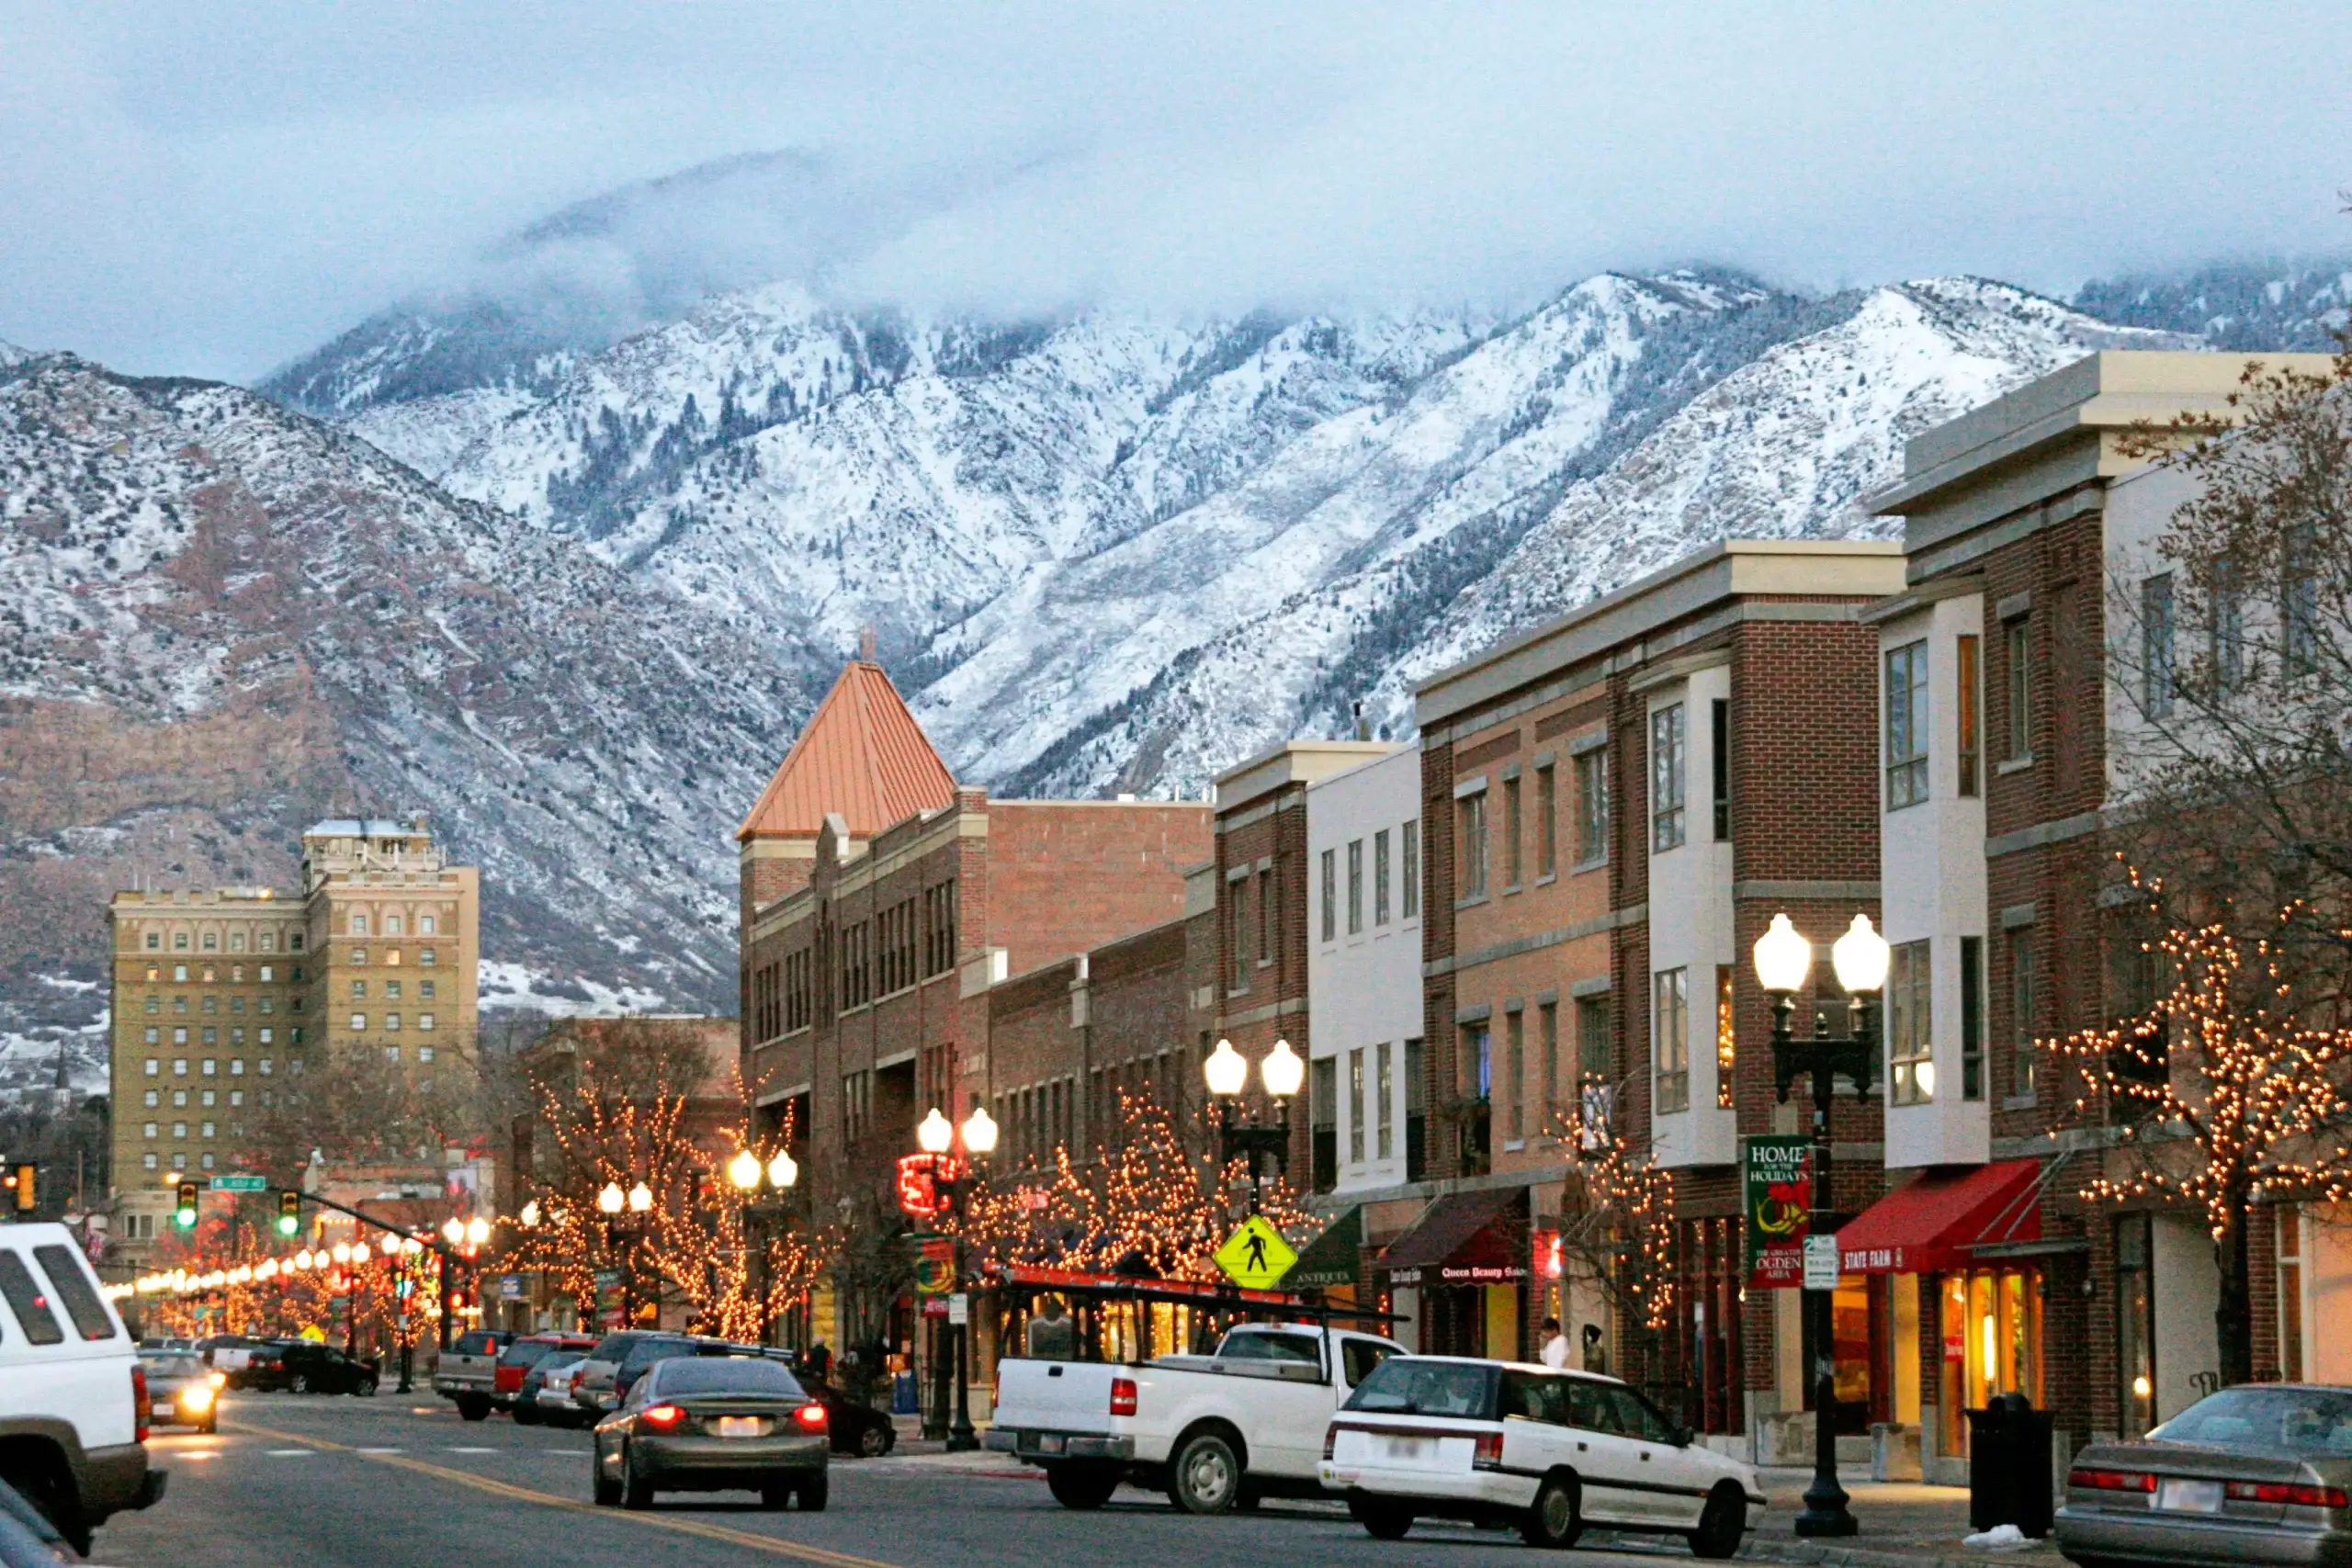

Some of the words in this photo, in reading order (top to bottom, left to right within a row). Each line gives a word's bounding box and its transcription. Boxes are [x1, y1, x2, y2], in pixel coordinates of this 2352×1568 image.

[1751, 1146, 1804, 1163] HOME
[1750, 1171, 1808, 1182] HOLIDAYS
[1756, 1256, 1802, 1269] OGDEN
[1845, 1250, 1867, 1269] STATE
[1870, 1249, 1891, 1267] FARM
[1442, 1267, 1470, 1278] Queen
[1472, 1267, 1502, 1278] Beauty
[1765, 1269, 1792, 1279] AREA
